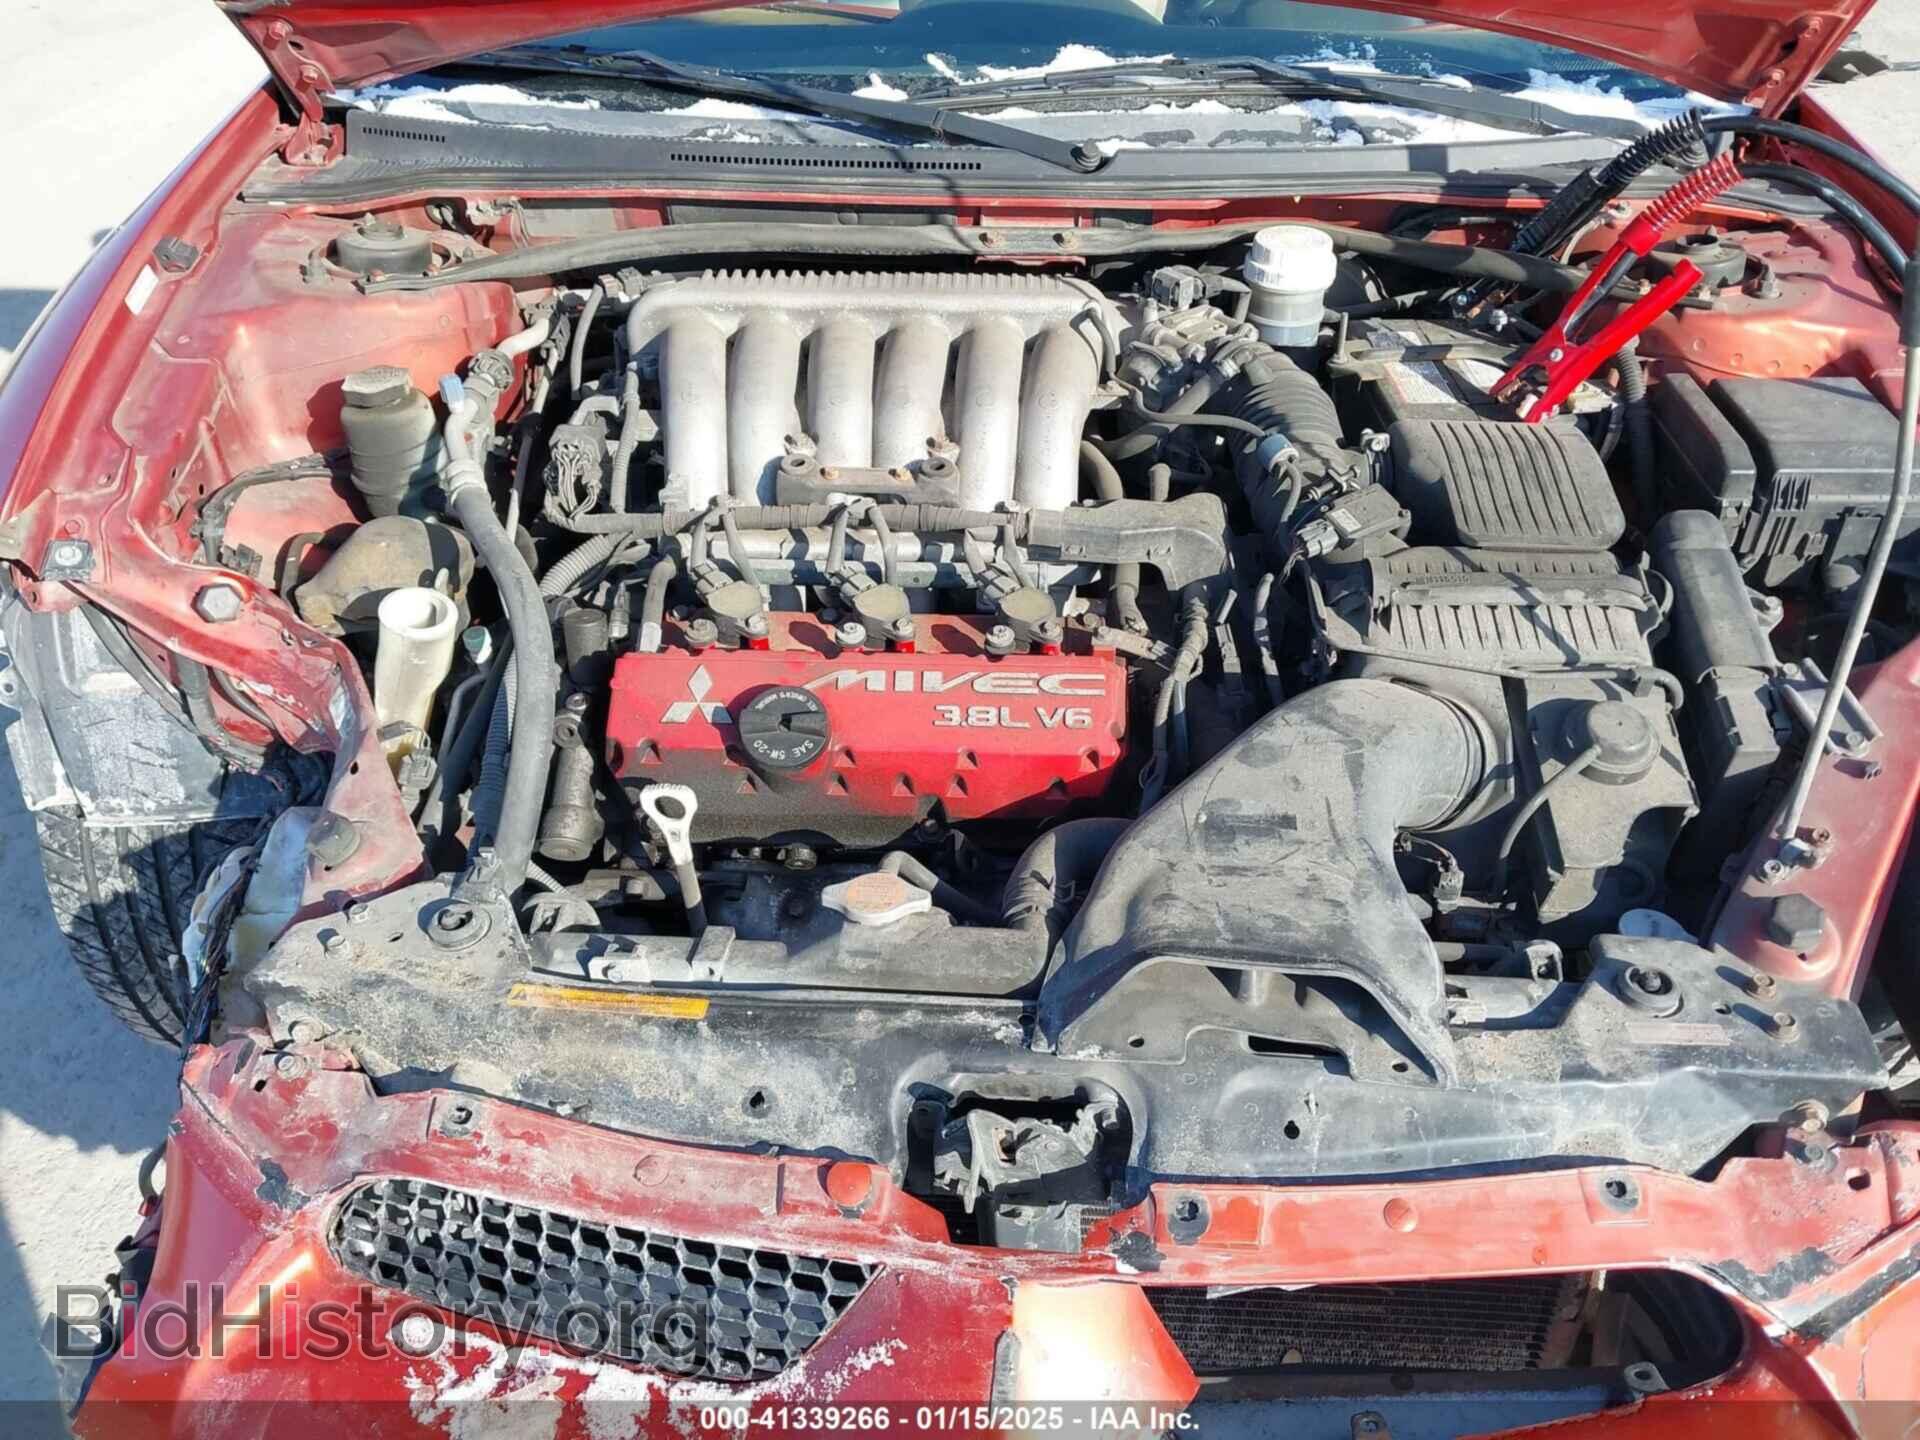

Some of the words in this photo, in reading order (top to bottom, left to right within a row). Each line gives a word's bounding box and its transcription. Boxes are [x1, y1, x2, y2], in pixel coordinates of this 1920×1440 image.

[802, 670, 1105, 696] MIVEC
[933, 704, 1031, 729] 3.8L
[1035, 706, 1093, 729] V6
[753, 739, 786, 760] 5W-20
[791, 739, 814, 758] SAE
